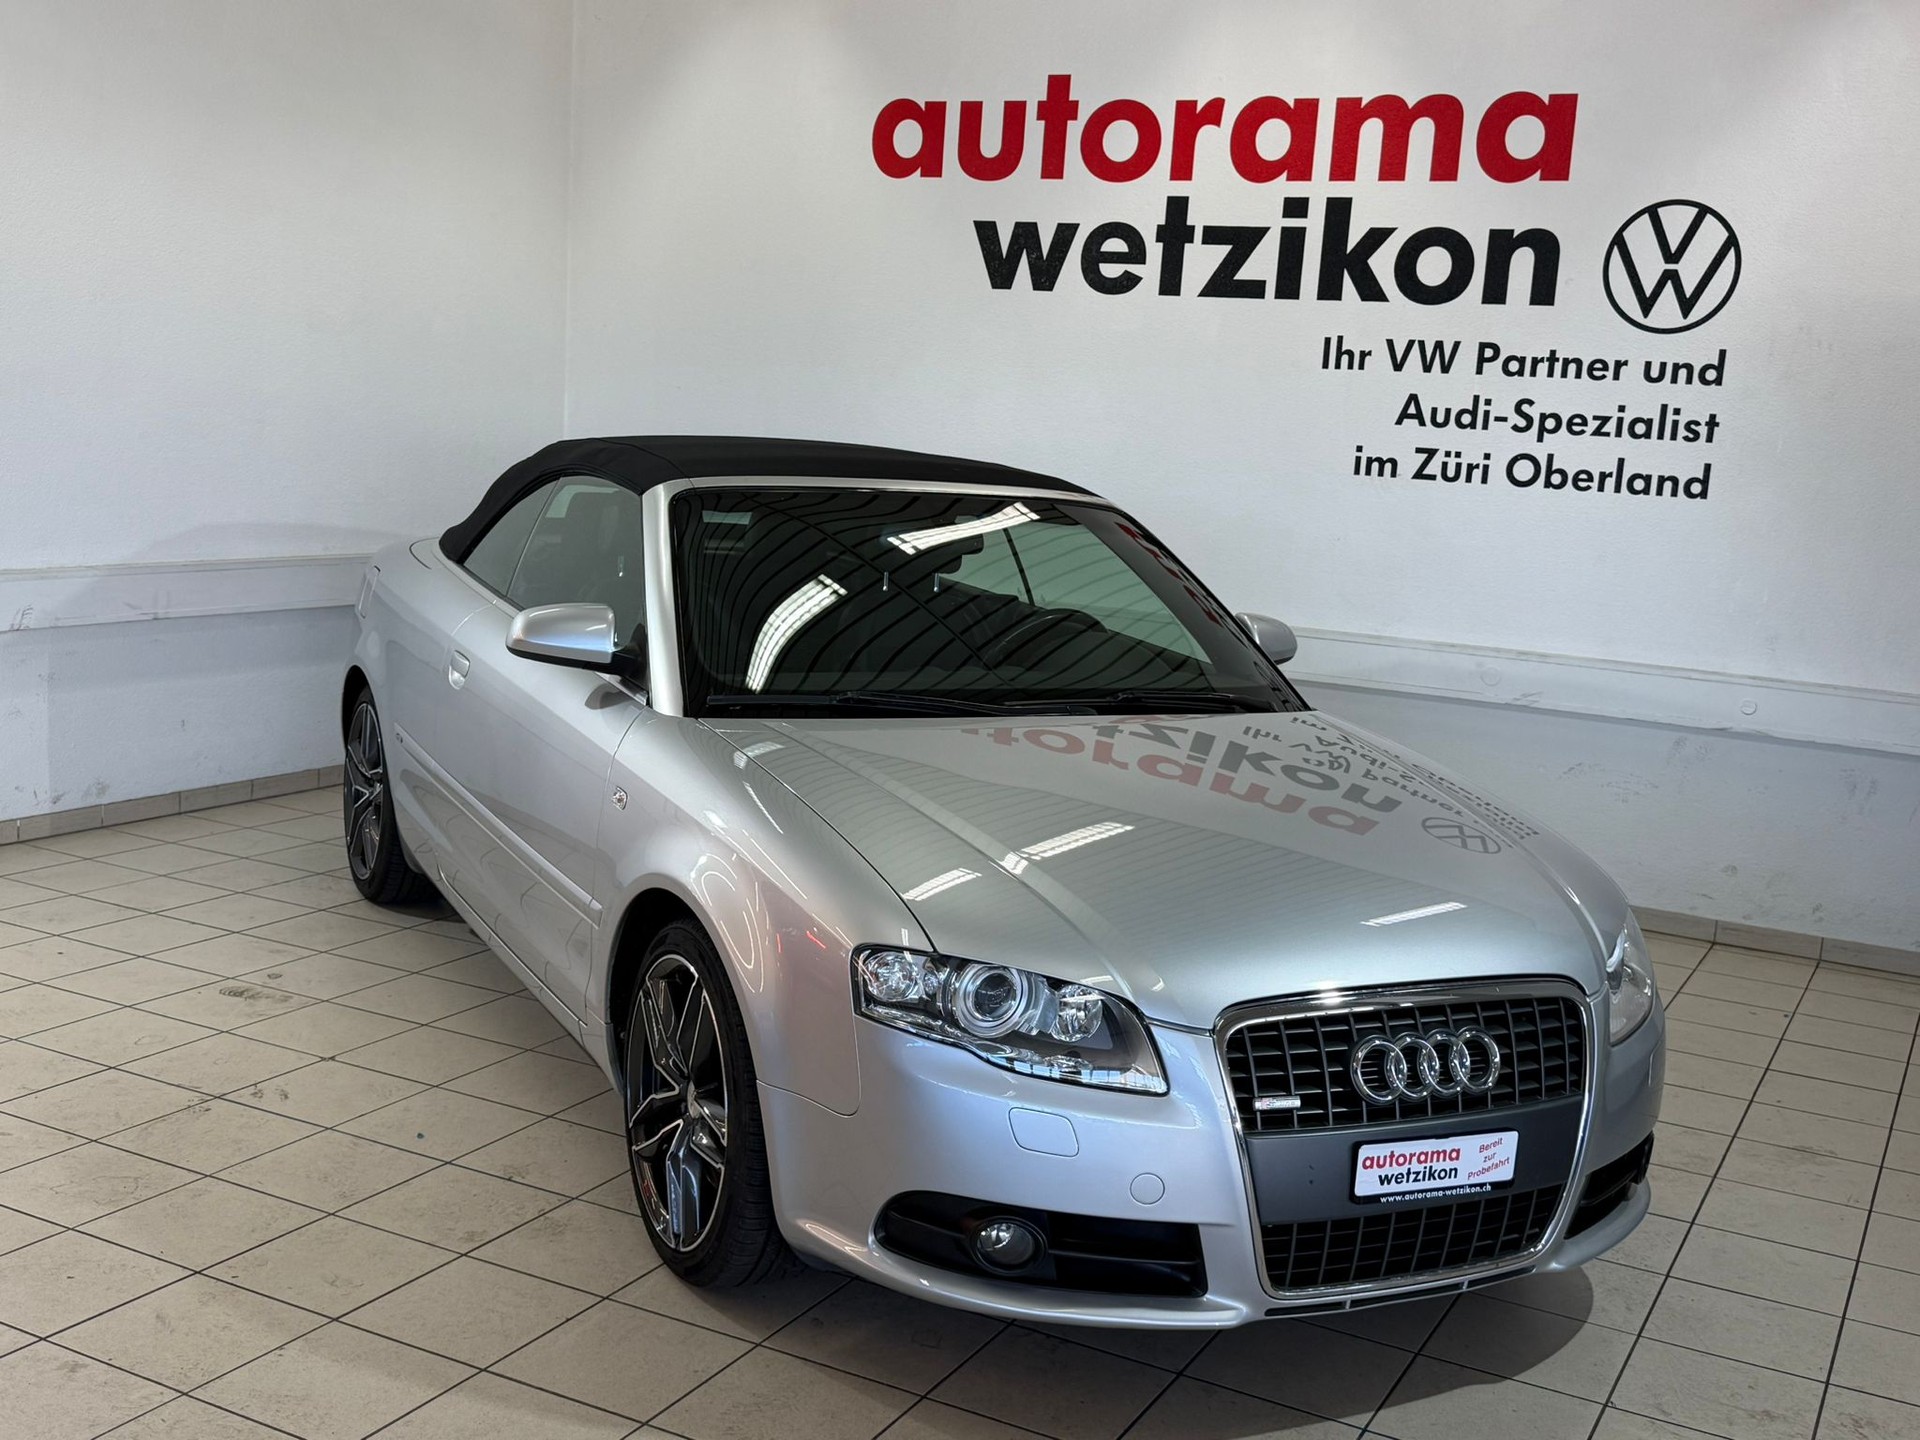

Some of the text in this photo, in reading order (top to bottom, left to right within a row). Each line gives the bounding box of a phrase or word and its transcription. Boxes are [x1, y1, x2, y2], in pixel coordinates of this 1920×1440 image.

[872, 74, 1579, 184] autorama
[973, 196, 1561, 306] wetzikon
[1321, 335, 1727, 387] Ihr VW Partner und
[1394, 393, 1720, 444] Audi-Spezialist
[1353, 445, 1712, 500] im Züri Oberland
[1479, 1137, 1503, 1153] Bereit
[1483, 1152, 1497, 1163] zur
[1362, 1147, 1461, 1170] autorama
[1467, 1156, 1510, 1181] Probefahrt
[1378, 1165, 1458, 1186] wetzikon
[1380, 1182, 1492, 1203] www.autorama-wetzikon.ch
